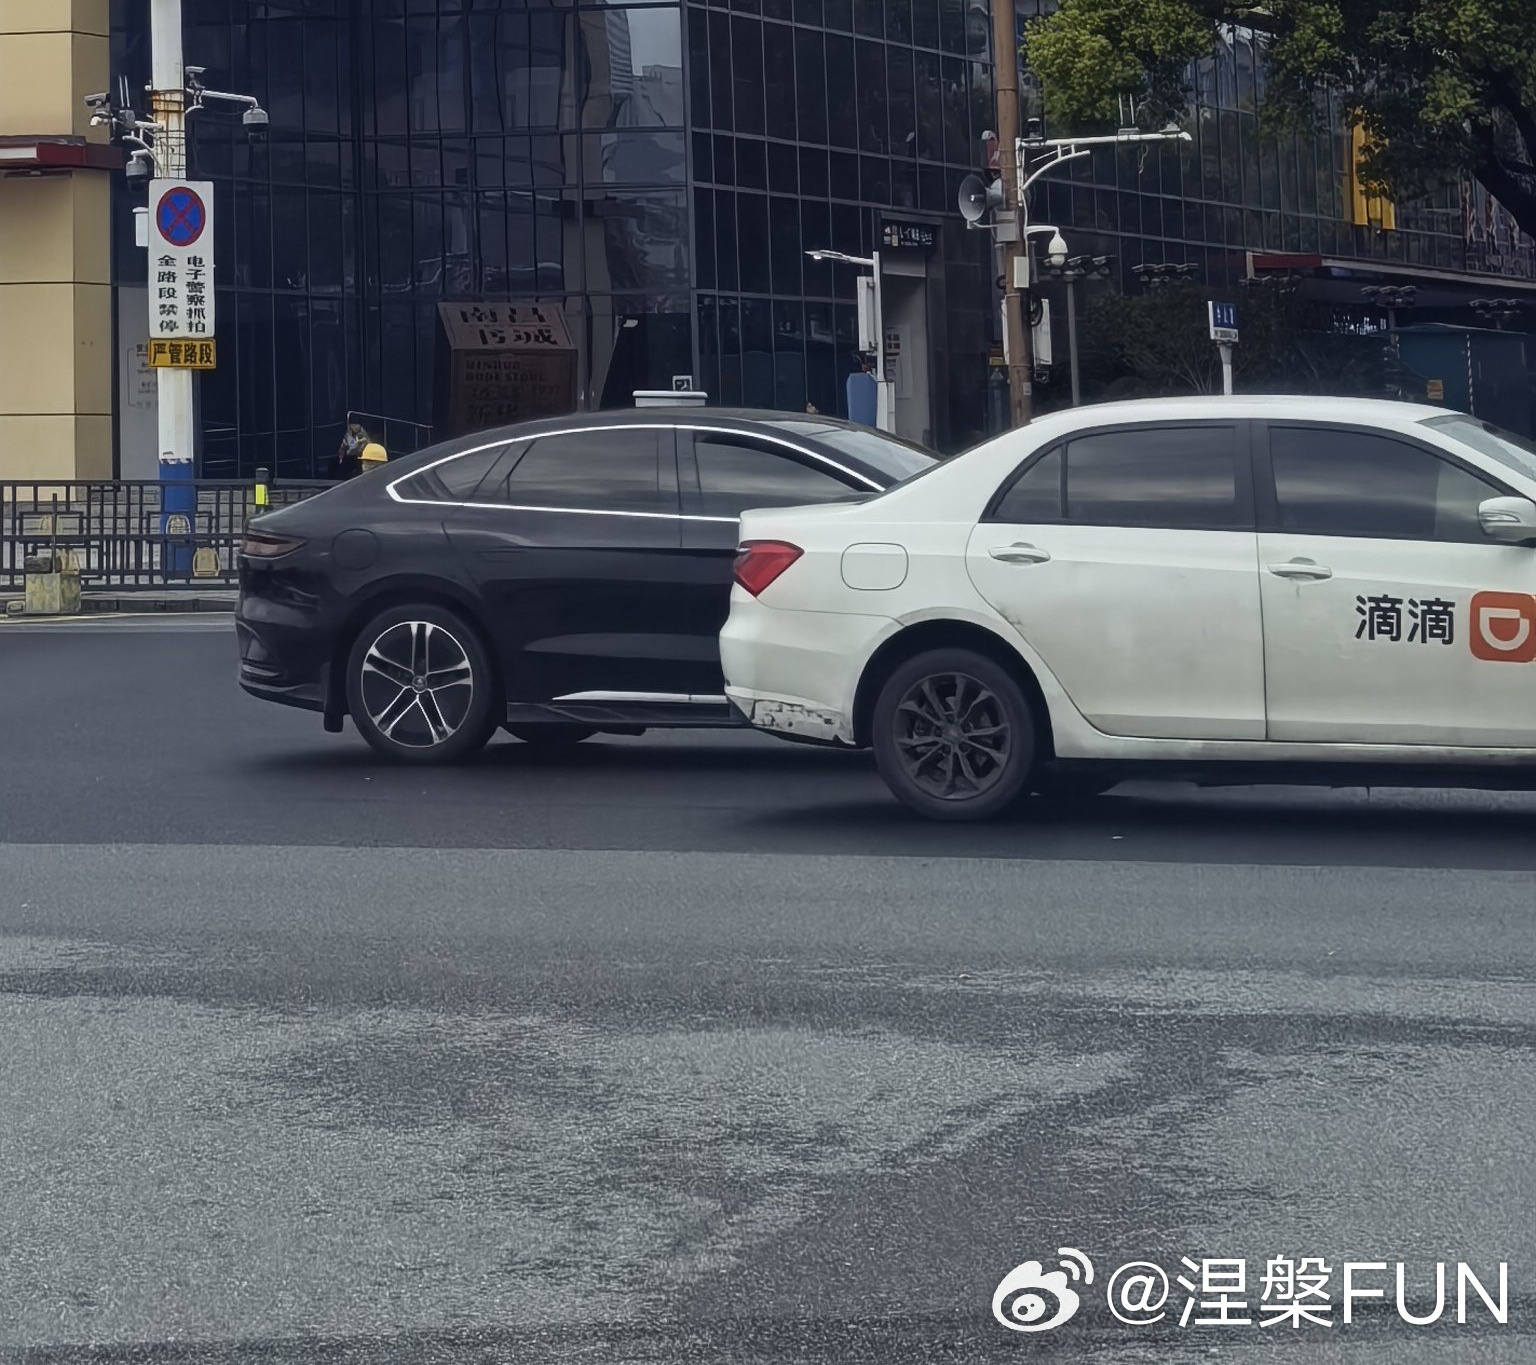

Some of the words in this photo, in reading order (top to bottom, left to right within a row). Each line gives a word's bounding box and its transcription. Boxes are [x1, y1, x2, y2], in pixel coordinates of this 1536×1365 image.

[157, 254, 179, 333] 全路段禁停
[186, 255, 206, 333] 电子警察抓拍
[151, 342, 213, 365] 严管路段
[1354, 593, 1455, 646] 滴滴
